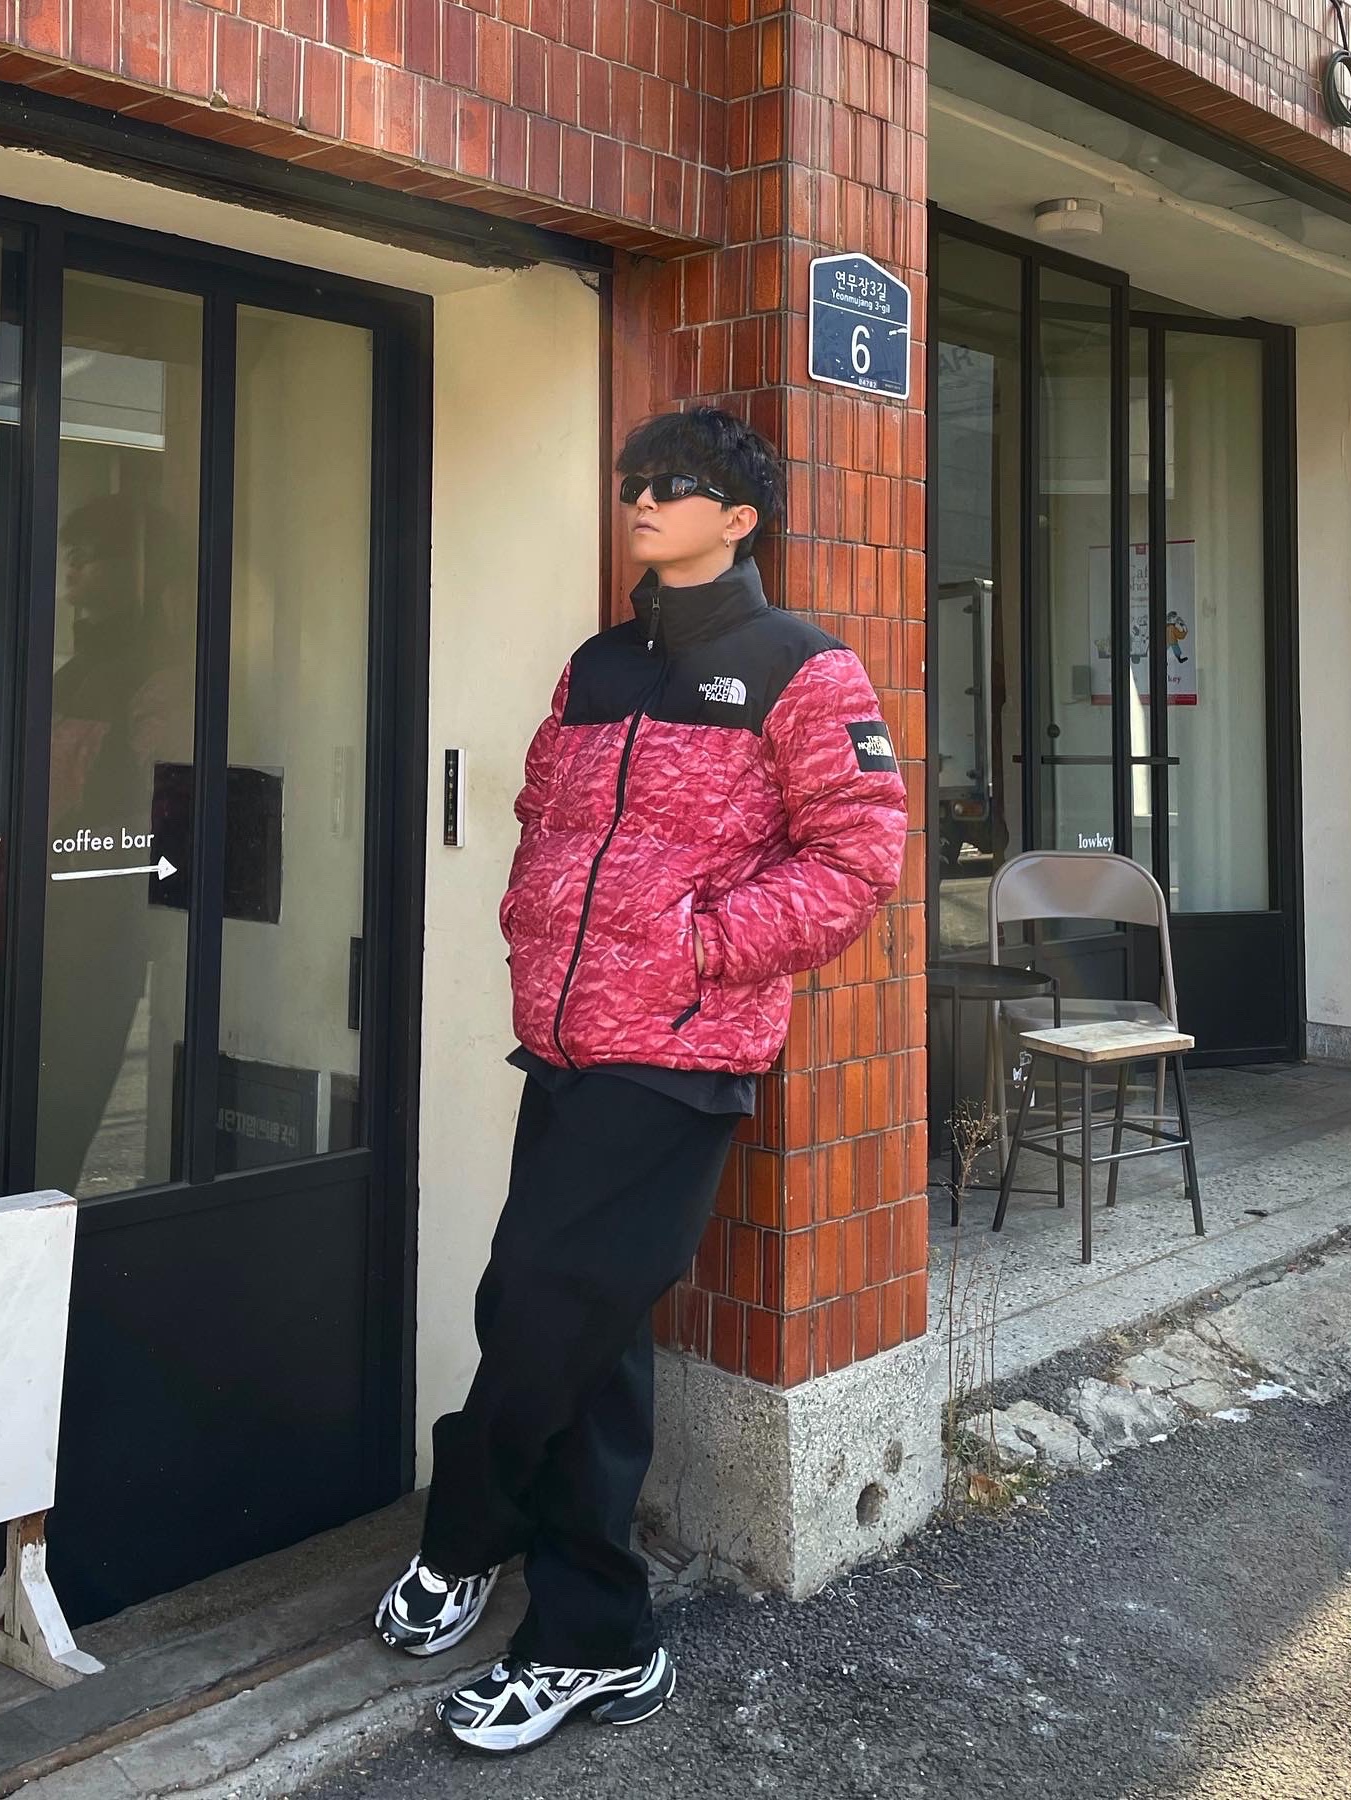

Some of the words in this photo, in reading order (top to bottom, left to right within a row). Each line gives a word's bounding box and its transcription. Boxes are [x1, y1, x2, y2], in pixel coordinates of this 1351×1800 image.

[835, 270, 887, 302] 연무장3길
[831, 288, 873, 311] Yeonmujang
[874, 300, 891, 314] 3-gil
[851, 324, 871, 374] 6
[698, 683, 731, 695] NORTH
[713, 676, 732, 687] THE
[704, 691, 728, 703] FACE
[52, 829, 114, 853] coffee
[121, 827, 155, 849] bar
[1078, 832, 1114, 852] lowkey
